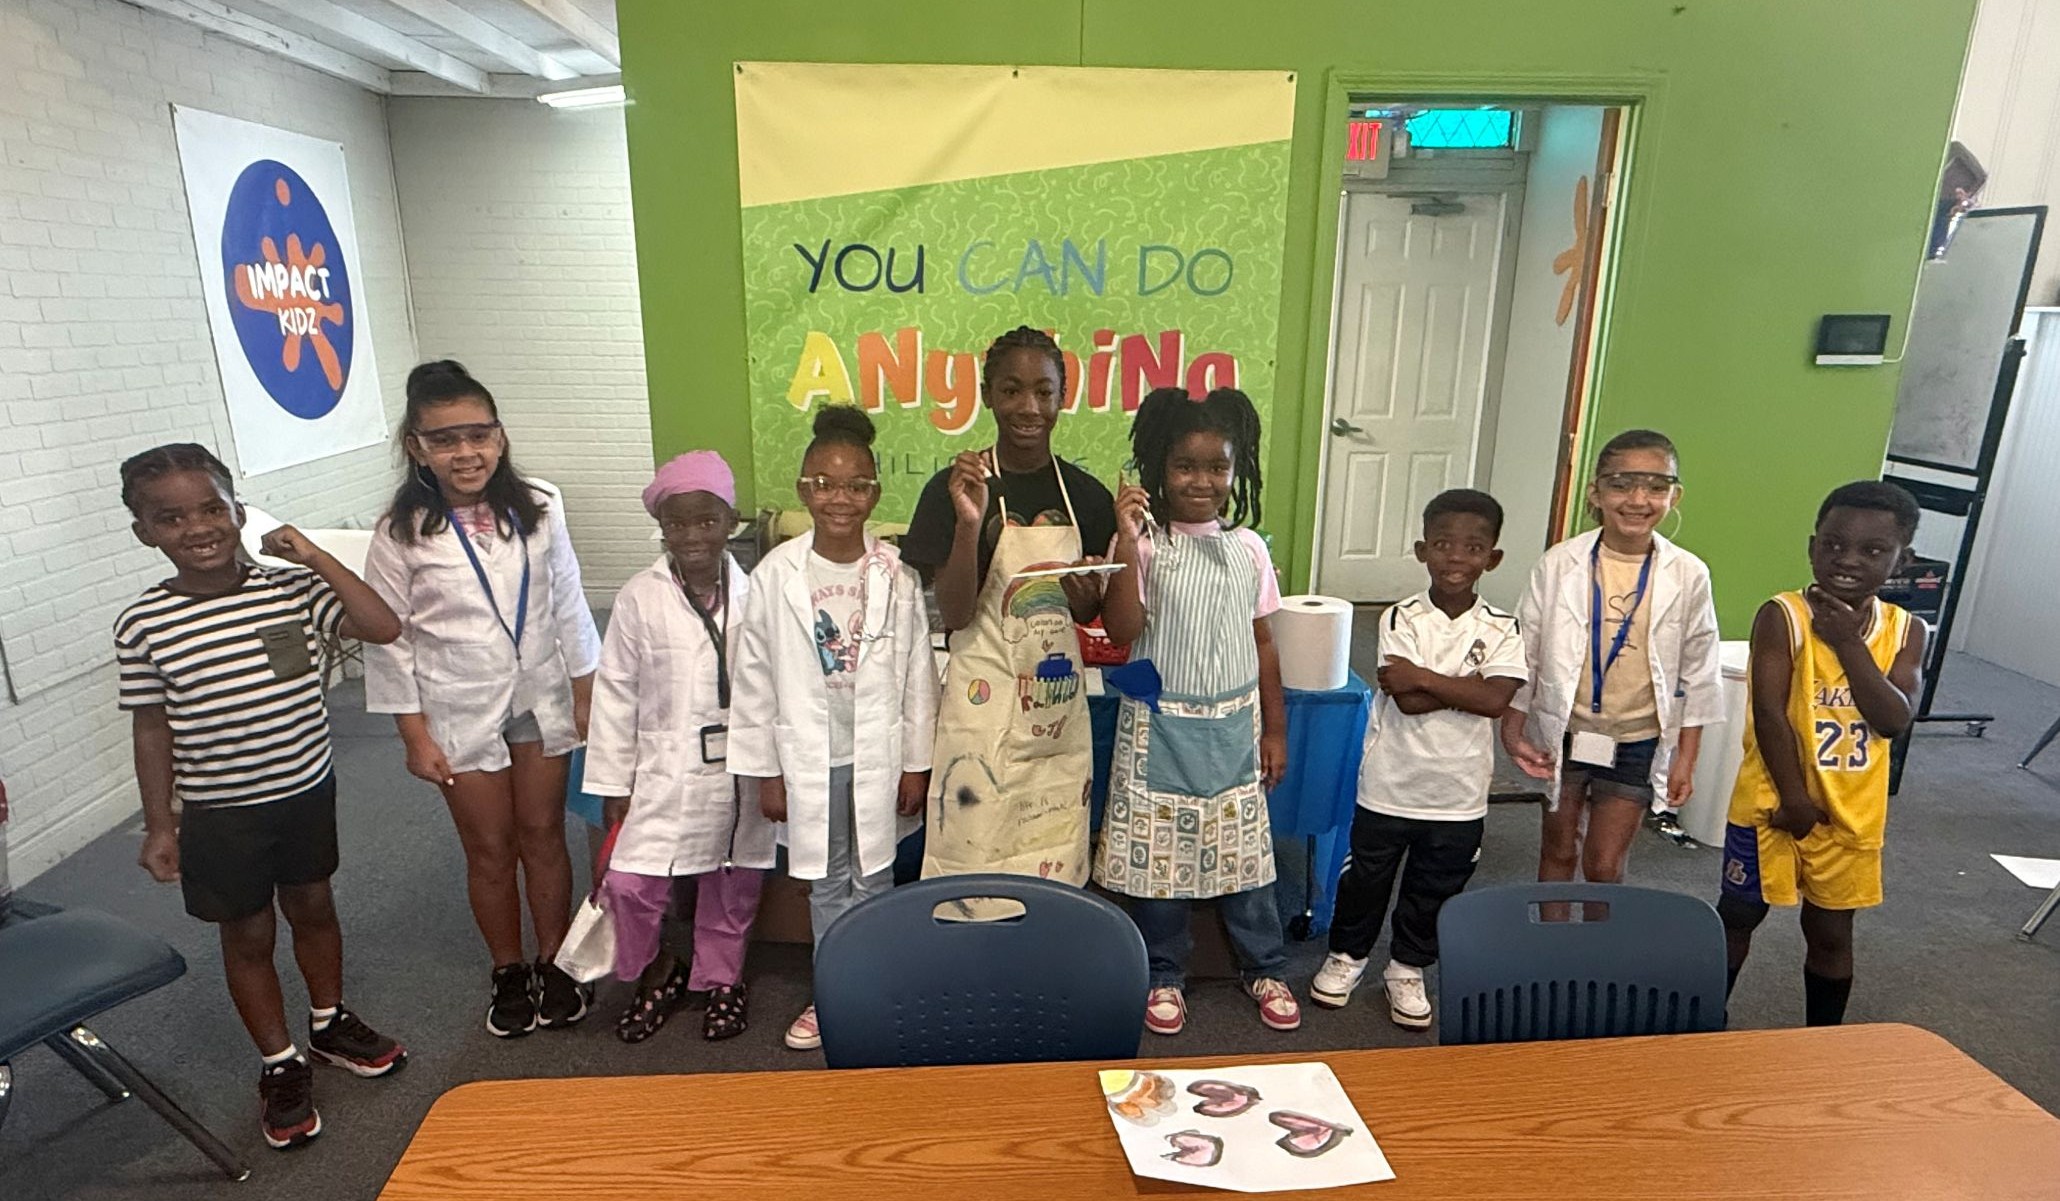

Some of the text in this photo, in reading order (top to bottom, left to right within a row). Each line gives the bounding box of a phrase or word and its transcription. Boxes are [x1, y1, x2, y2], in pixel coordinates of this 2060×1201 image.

[1346, 122, 1382, 160] XIT
[246, 262, 331, 301] IMPACT
[793, 238, 1234, 296] YOU CAN DO
[277, 307, 319, 336] KIDZ
[1815, 719, 1869, 770] 23
